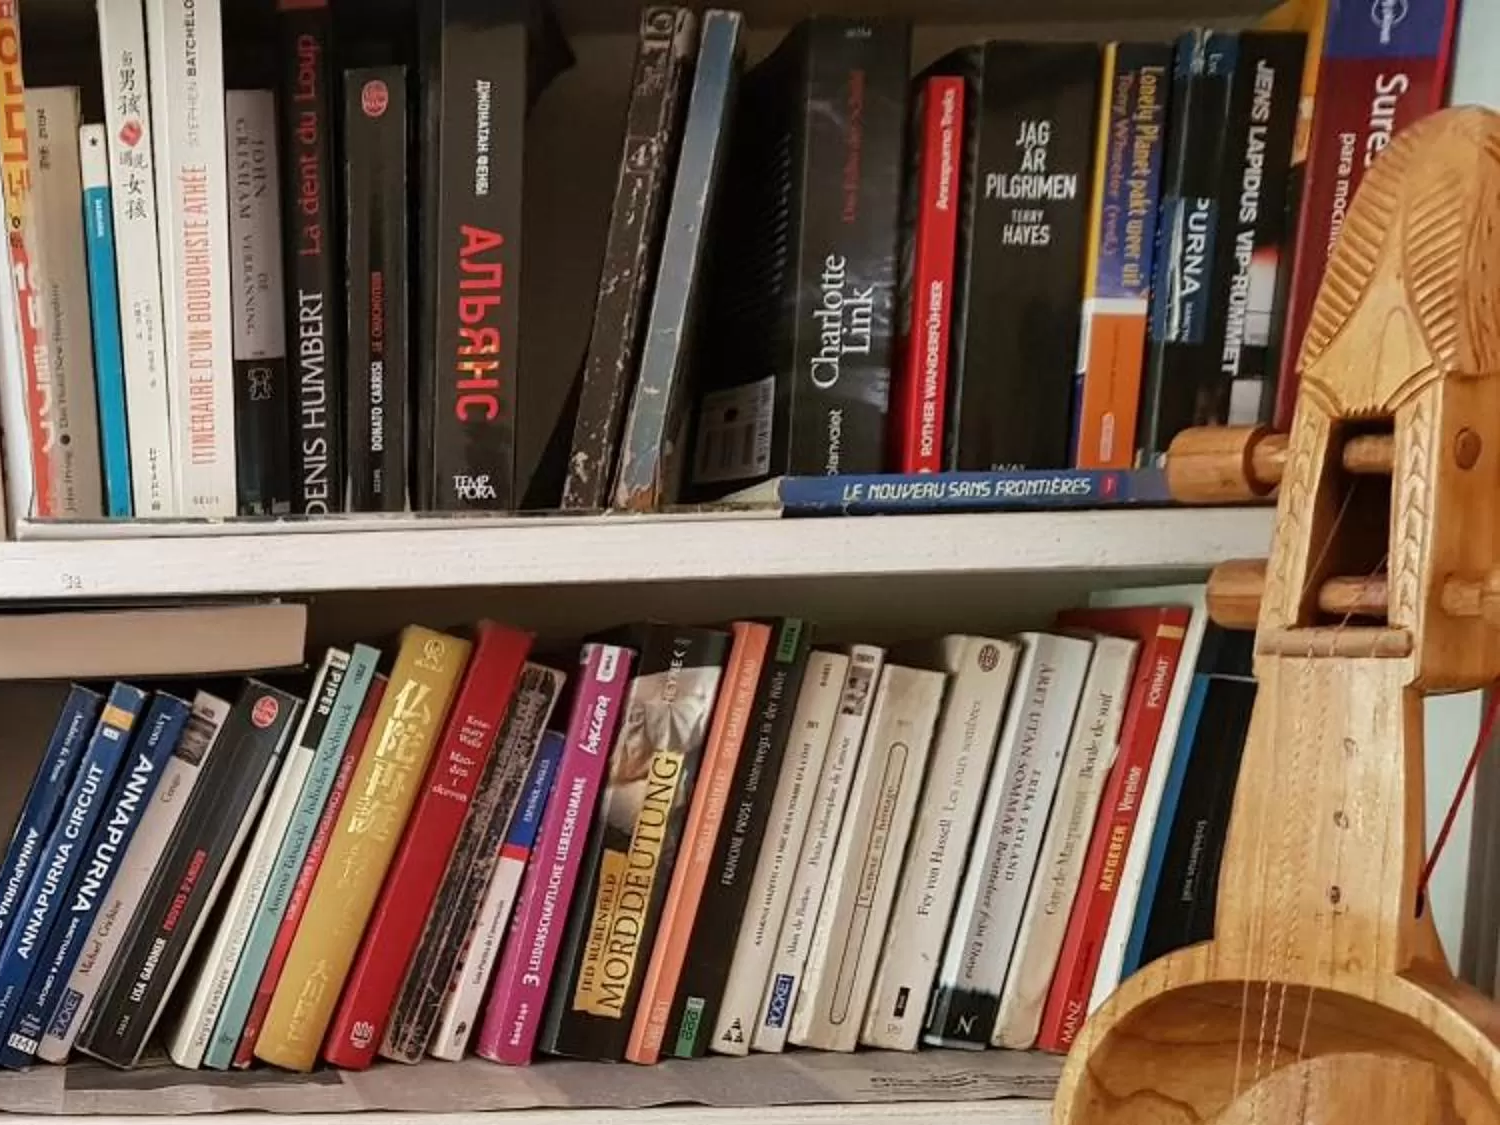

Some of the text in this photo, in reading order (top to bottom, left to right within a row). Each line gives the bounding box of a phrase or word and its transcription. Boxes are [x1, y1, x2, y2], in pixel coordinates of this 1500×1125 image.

[295, 34, 322, 257] La dent du Loup
[1015, 120, 1051, 147] JAG
[1131, 64, 1165, 177] Lonely Planet
[475, 154, 490, 196] ФЕНБИ
[1335, 132, 1358, 177] para
[985, 173, 1077, 201] PILGRIMEN
[1002, 223, 1051, 247] HAYES
[1010, 208, 1045, 224] TERRY
[1221, 60, 1276, 376] JENS LAPIDUS VIP-RUMMET
[455, 224, 505, 422] АЛЬЯНС
[811, 253, 847, 390] Charlotte
[842, 285, 874, 355] Link
[920, 280, 944, 457] ROTHER WANDERFÜHRER
[299, 289, 329, 519] DENIS HUMBERT
[371, 405, 384, 451] DONATO
[843, 477, 1092, 502] LE NOUVEAU SANS FRONTIÈRES
[318, 667, 343, 717] PIPER
[1147, 656, 1170, 709] FORMAT
[1026, 768, 1042, 807] ERIKA
[17, 841, 73, 960] ANNAPURNA
[64, 763, 104, 841] CIRCUIT
[71, 753, 156, 914] ANNAPURNA
[1099, 823, 1128, 893] RATGEBER
[522, 776, 588, 989] 3 LEIDENSCHAFTLICHE LIEBESROMANE
[594, 753, 681, 1011] MORDDEUTUNG
[579, 872, 618, 994] JED RUBENFELD
[47, 987, 84, 1040] POCKET
[129, 973, 148, 1003] LISA
[765, 973, 794, 1030] POCKET
[1062, 999, 1082, 1044] MANZ
